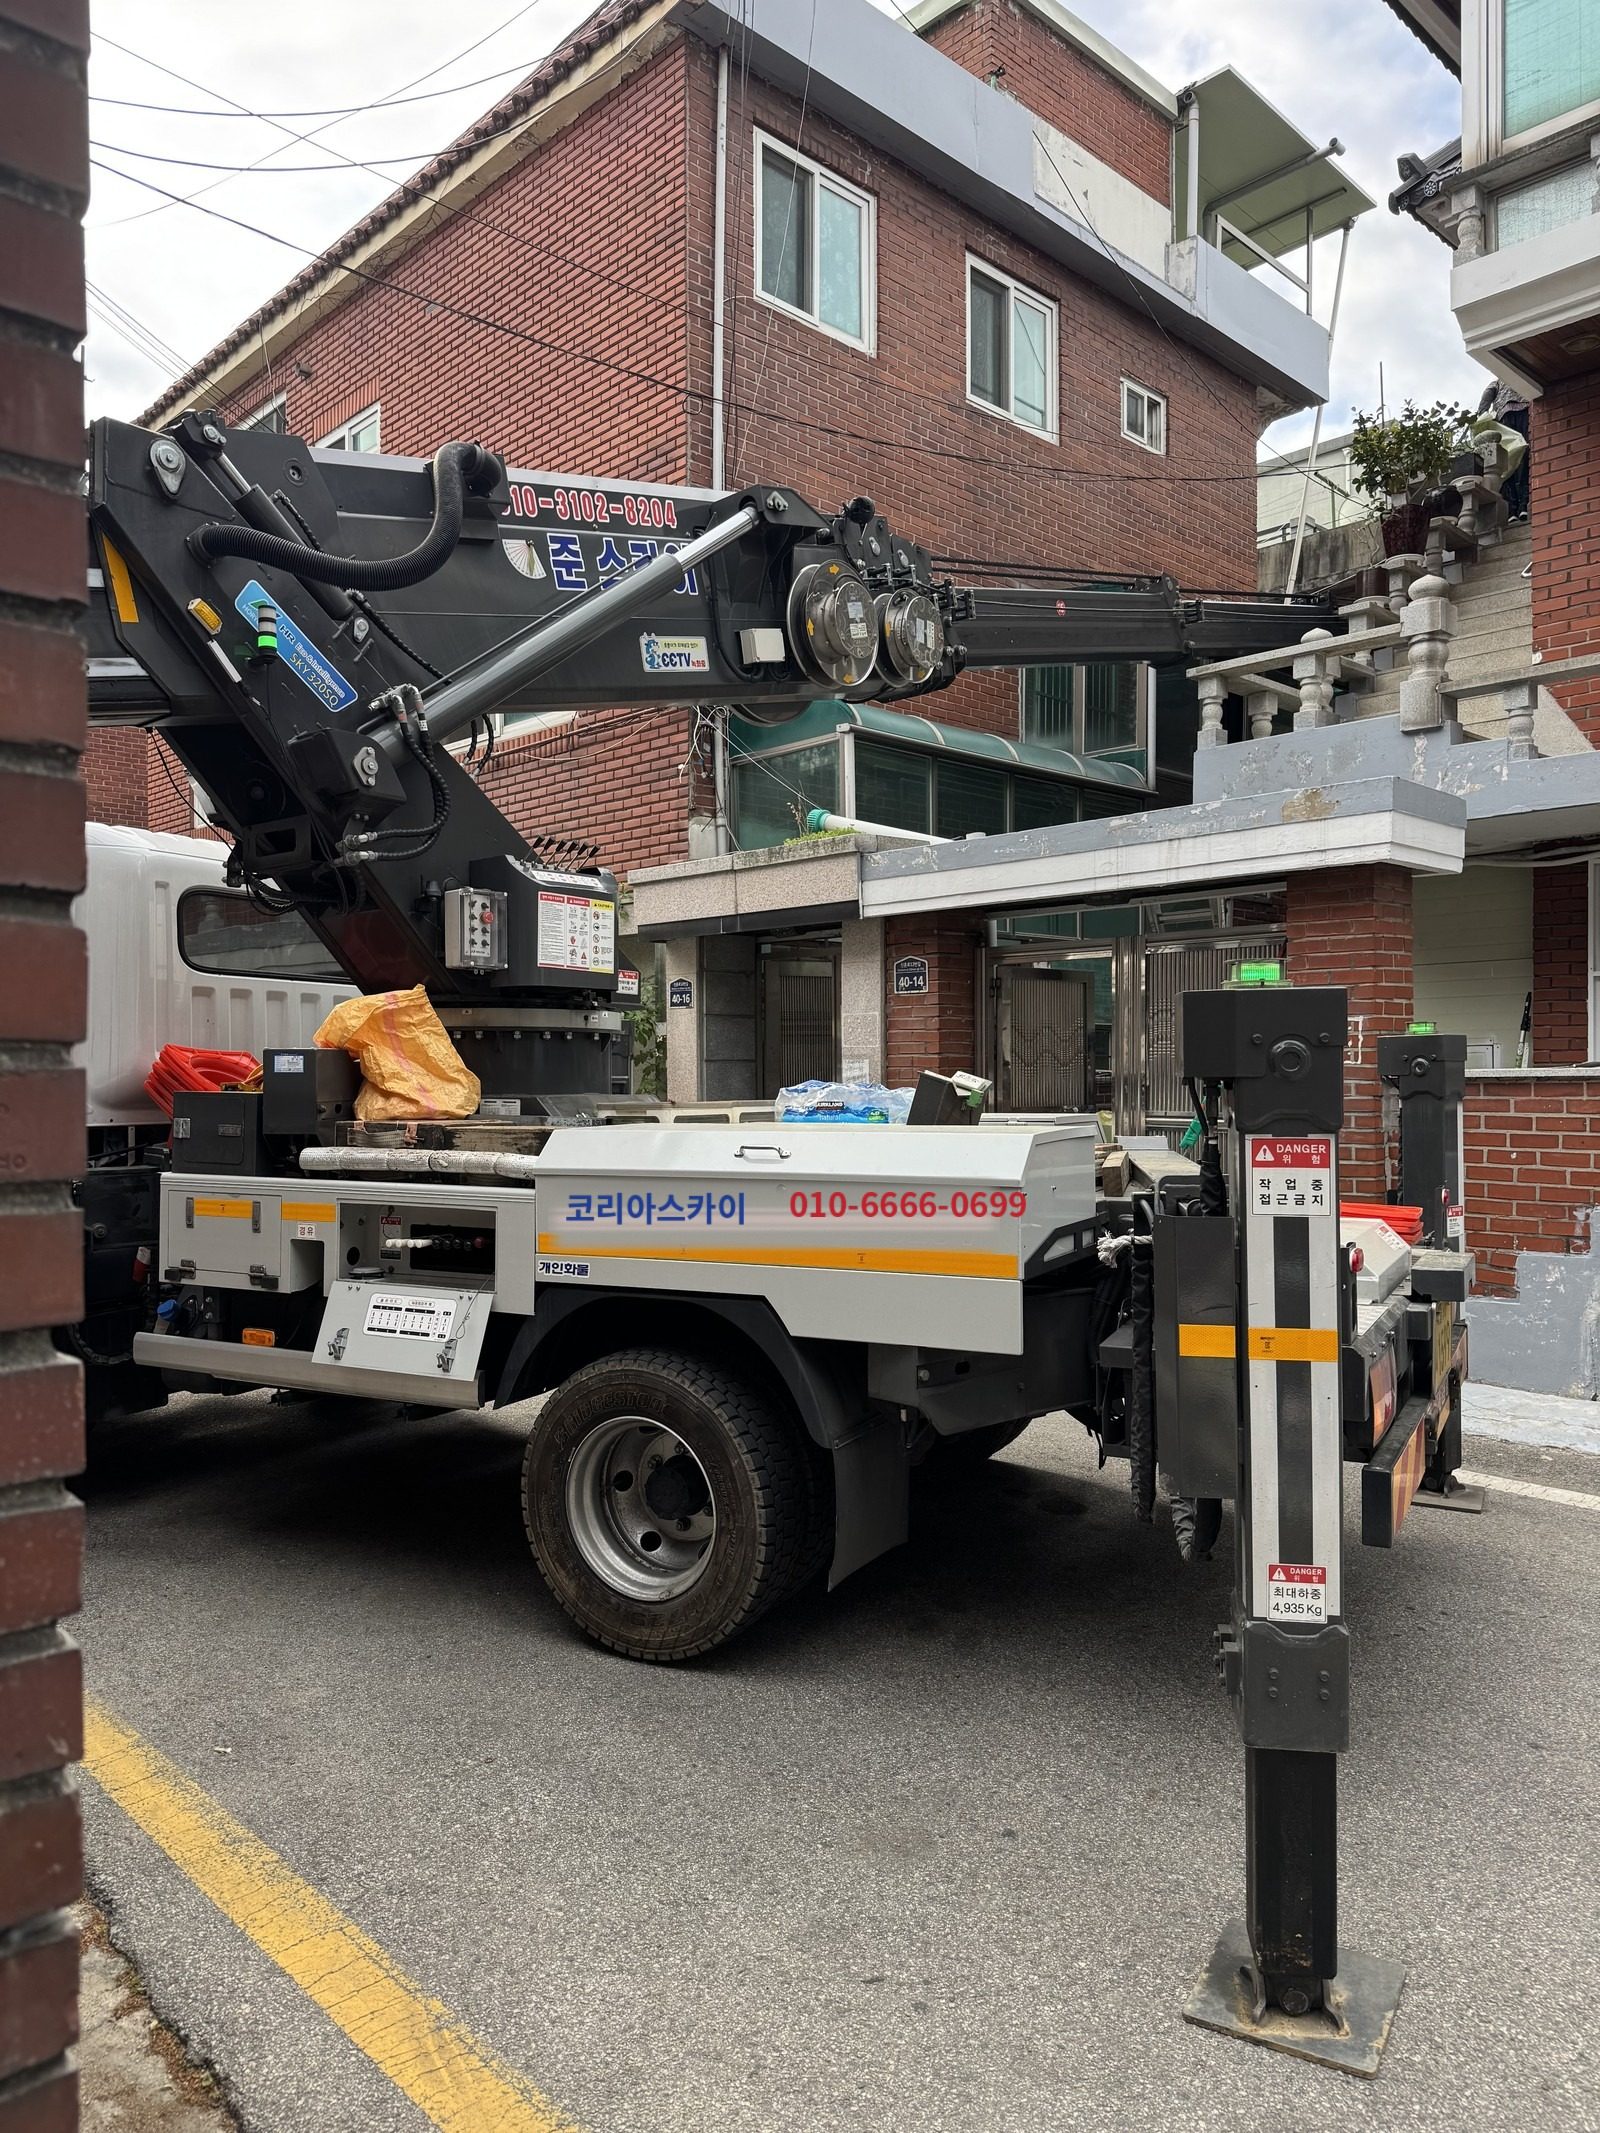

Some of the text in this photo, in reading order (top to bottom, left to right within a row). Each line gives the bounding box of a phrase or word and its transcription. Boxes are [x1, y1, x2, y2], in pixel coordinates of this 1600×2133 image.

[502, 485, 678, 529] 10-3102-8204
[547, 533, 589, 591] 준
[279, 623, 296, 645] HR
[661, 652, 691, 667] CCTV
[898, 975, 924, 988] 40-14
[671, 993, 691, 1004] 40-16
[1276, 1144, 1327, 1154] DANGER
[1259, 1193, 1323, 1206] 접근금지
[538, 1261, 590, 1277] 개인화물
[1290, 1567, 1323, 1576] DANGER
[1273, 1586, 1322, 1600] 최대하중
[1272, 1602, 1323, 1617] 4,935 Kg
